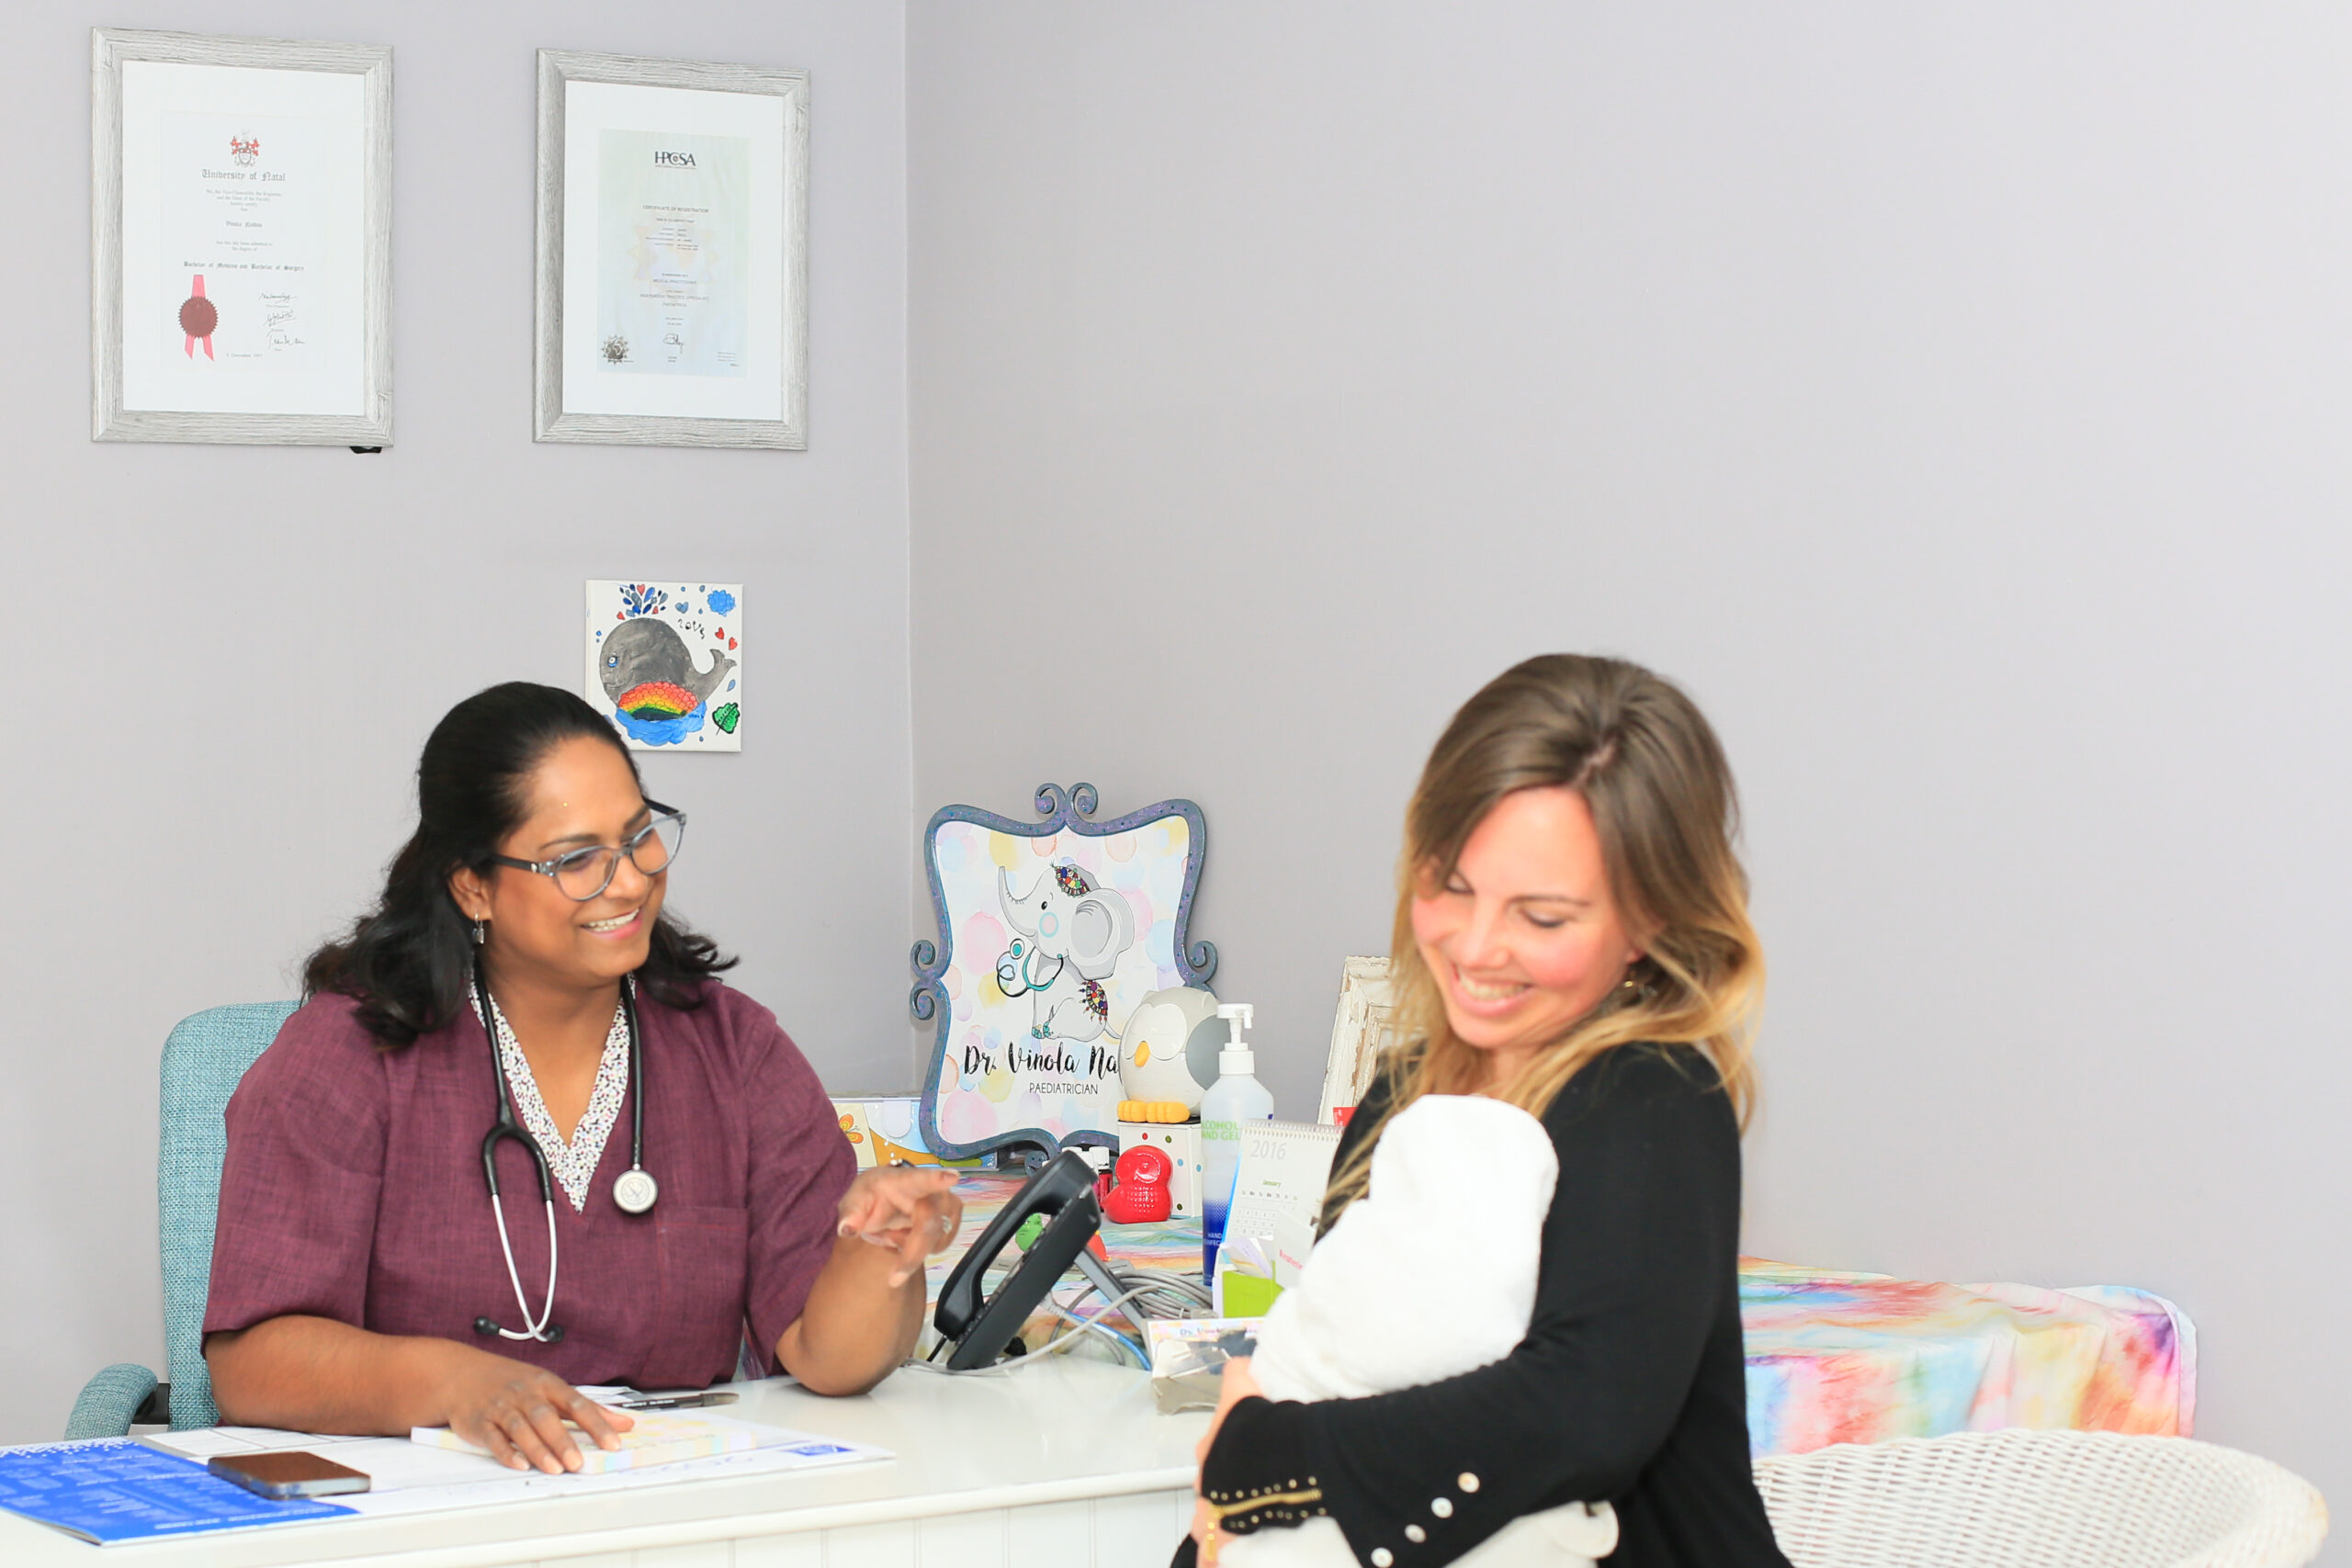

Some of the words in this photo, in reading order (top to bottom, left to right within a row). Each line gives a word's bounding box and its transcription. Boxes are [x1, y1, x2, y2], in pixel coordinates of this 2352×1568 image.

[201, 169, 245, 181] University
[250, 171, 257, 181] of
[261, 172, 287, 182] Natal
[965, 1045, 996, 1076] Dr.
[1008, 1042, 1080, 1074] Vinola
[1090, 1045, 1119, 1079] Na
[1029, 1082, 1098, 1095] PAEDIATRICIAN
[1221, 1131, 1240, 1141] GEL
[1250, 1139, 1287, 1161] 2016
[1262, 1179, 1282, 1188] January
